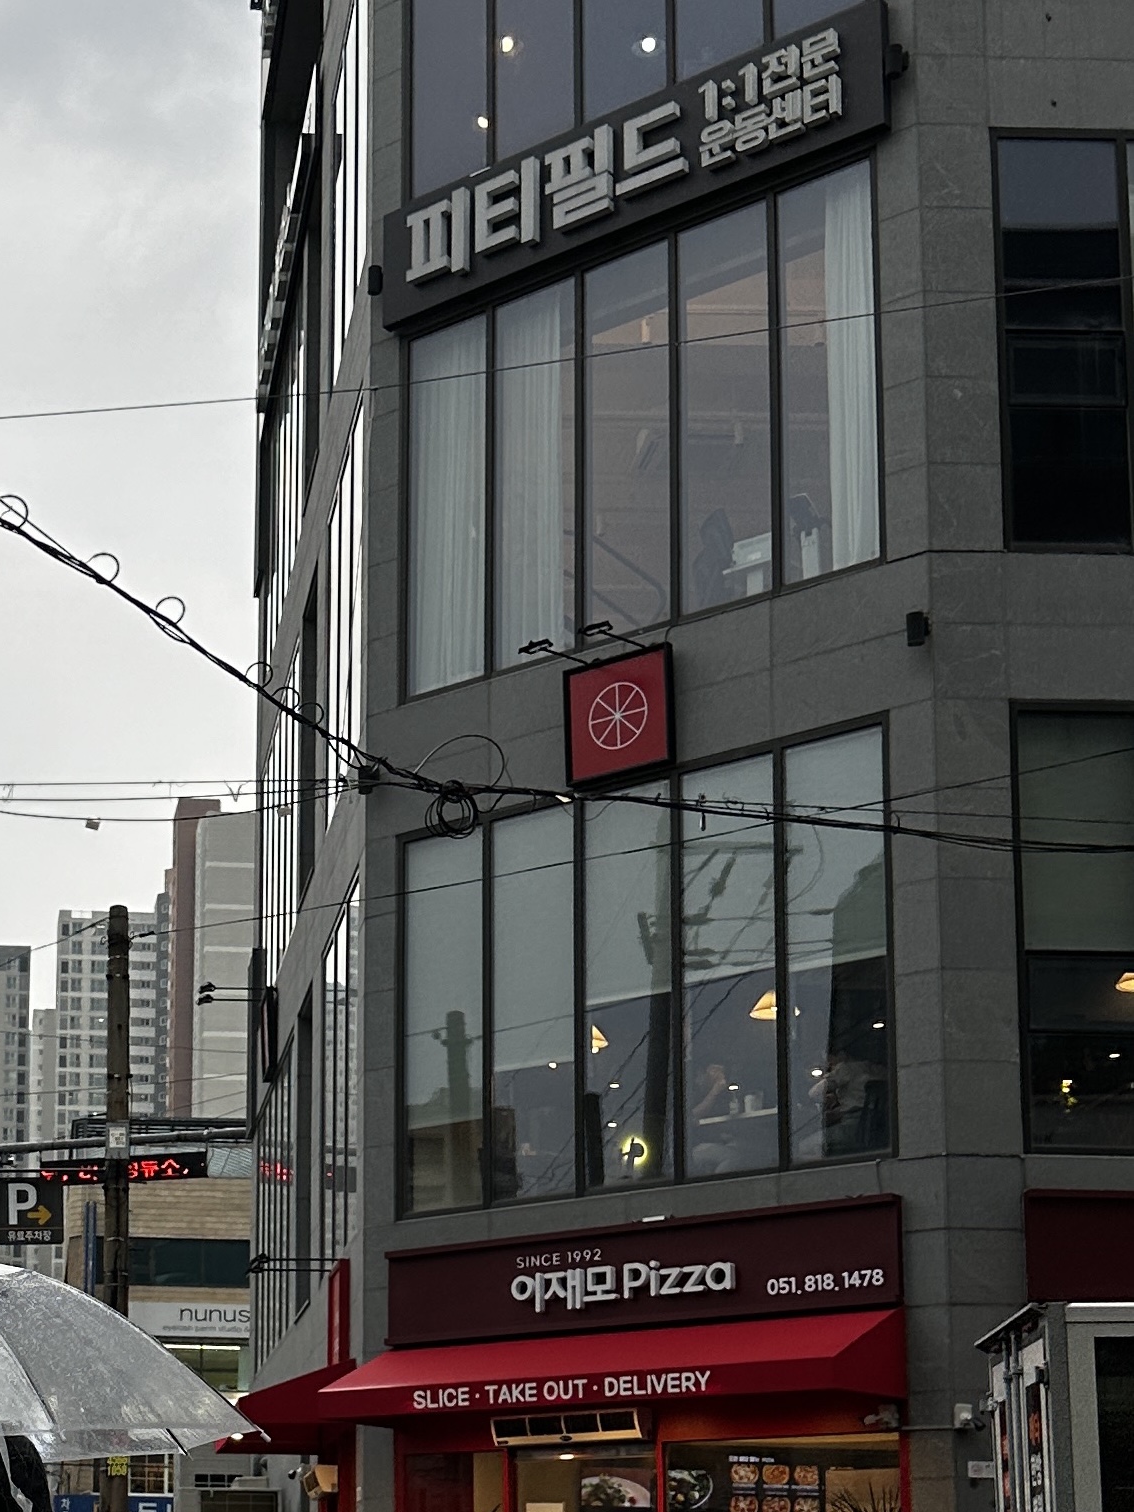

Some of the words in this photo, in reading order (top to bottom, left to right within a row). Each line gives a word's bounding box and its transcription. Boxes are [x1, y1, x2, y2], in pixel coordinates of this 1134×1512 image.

[700, 75, 842, 167] 운동센터
[406, 101, 689, 284] 피티필드
[8, 1183, 37, 1226] P
[7, 1229, 52, 1243] 유료주차장
[516, 1253, 561, 1269] SINCE
[566, 1249, 603, 1264] 1992
[511, 1265, 620, 1313] 이재모
[623, 1260, 736, 1299] Pizza
[413, 1386, 470, 1410] SLICE
[484, 1382, 537, 1405] TAKE
[543, 1378, 588, 1400] OUT
[604, 1370, 711, 1397] DELIVERY
